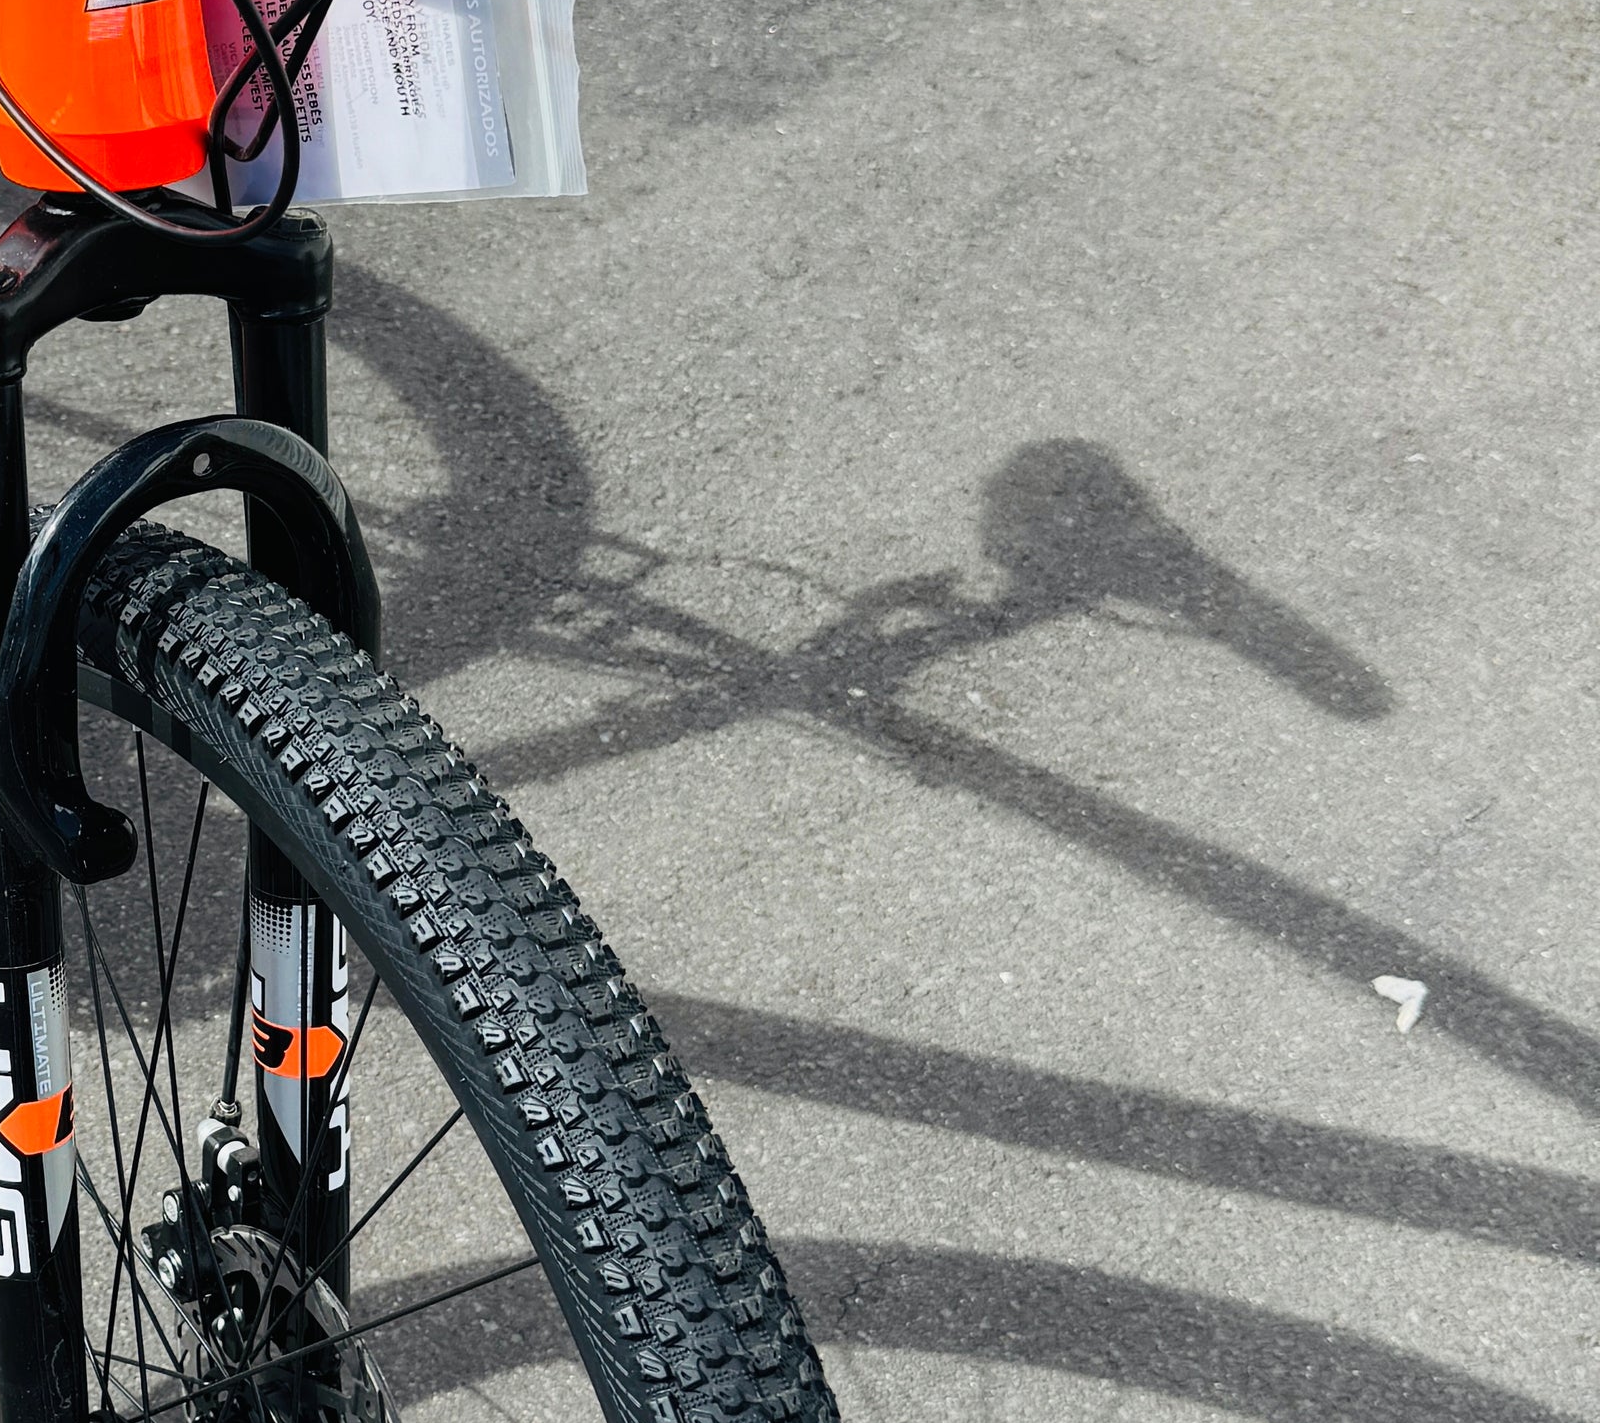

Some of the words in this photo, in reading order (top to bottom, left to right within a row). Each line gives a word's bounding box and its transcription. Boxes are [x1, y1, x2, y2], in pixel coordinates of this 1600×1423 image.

[265, 1, 277, 18] LE
[405, 14, 420, 56] FROM
[383, 26, 398, 58] AND
[391, 62, 410, 116] MOUTH
[397, 35, 420, 116] CARRIAGES
[467, 12, 499, 157] AUTORIZADOS
[293, 96, 312, 143] PETITS
[29, 980, 52, 1095] ULTIMATE
